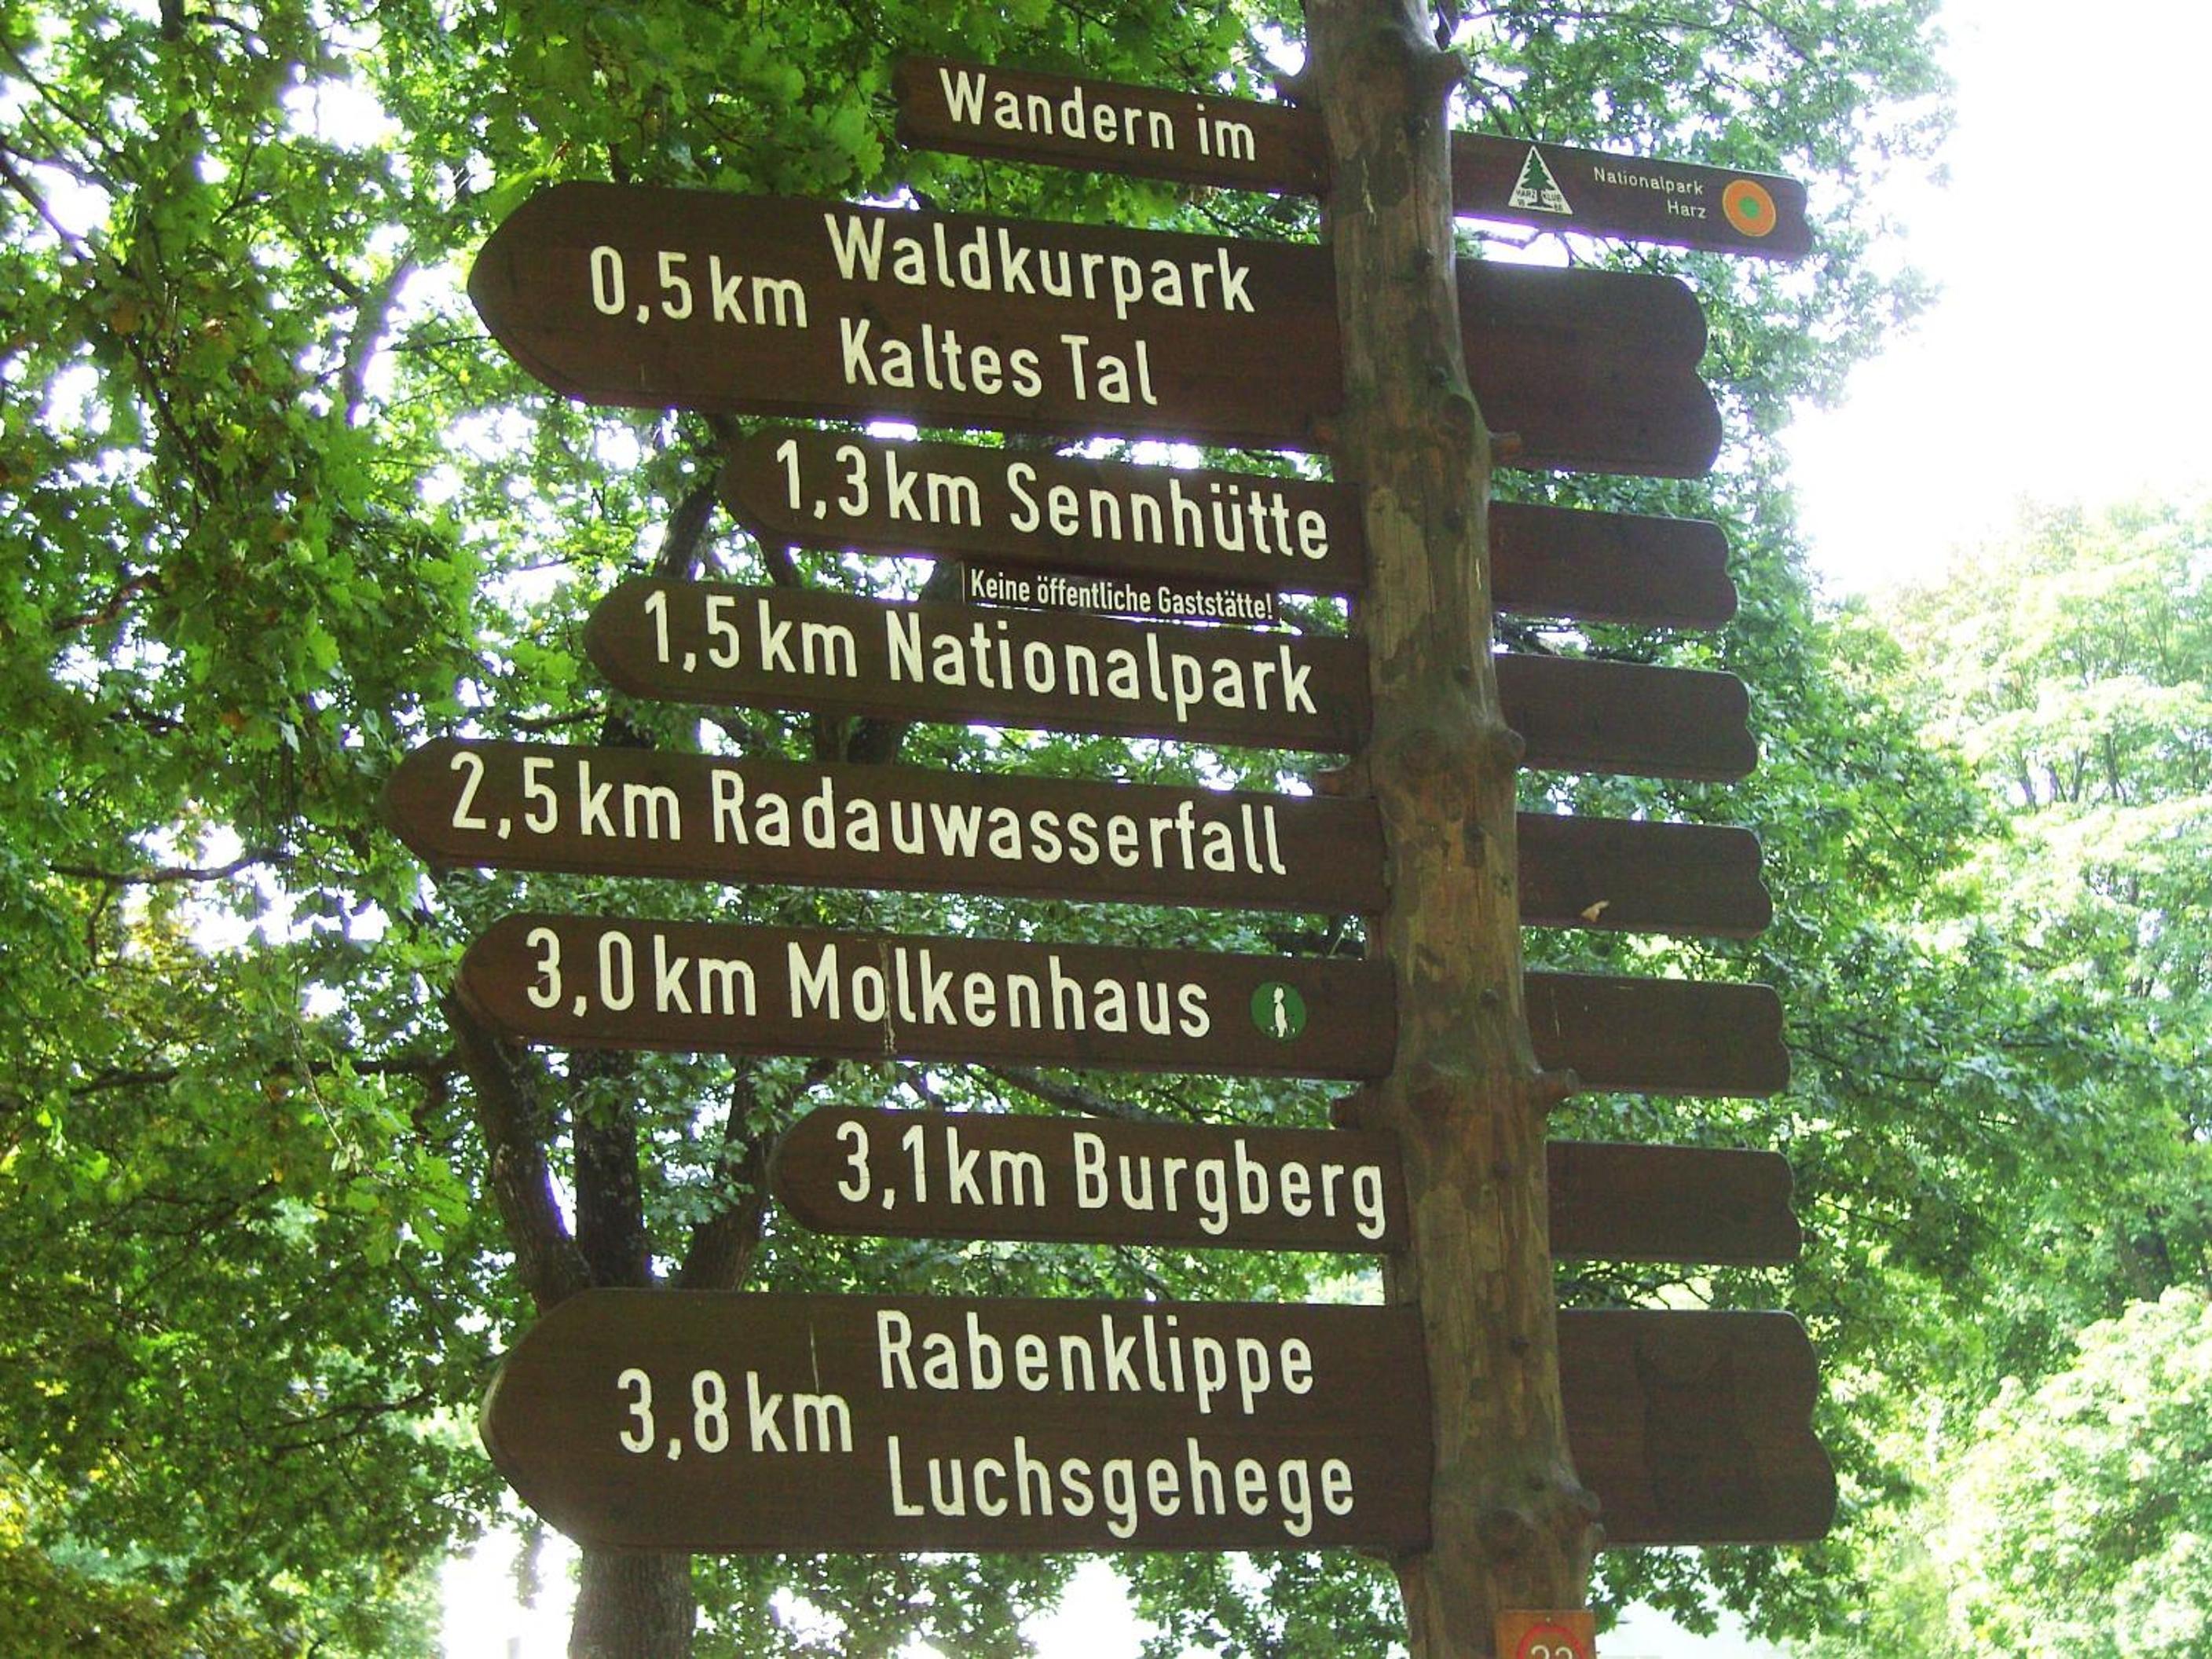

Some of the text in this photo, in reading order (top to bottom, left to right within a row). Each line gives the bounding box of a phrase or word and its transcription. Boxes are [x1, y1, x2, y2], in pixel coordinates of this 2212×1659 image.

[938, 67, 1256, 162] Wandern im
[1593, 167, 1704, 195] Nationalpark
[1667, 200, 1707, 219] Harz
[589, 244, 808, 329] 0,5 km
[825, 212, 1256, 320] Waldkurpark
[839, 317, 1159, 406] Kaltes Tal
[775, 438, 1329, 560] 1,3 km Sennhütte
[971, 568, 1274, 620] Keine öffentliche Gaststätte!
[643, 589, 1318, 722] 1,5 km Nationalpark
[449, 750, 1287, 876] 2,5 km Radauwasserfall
[526, 926, 1211, 1038] 3,0 km Molkenhaus
[835, 1119, 1386, 1240] 3,1 km Burgberg
[617, 1367, 854, 1462] 3,8 km
[876, 1309, 1314, 1415] Rabenklippe
[887, 1434, 1354, 1540] Luchsgehege
